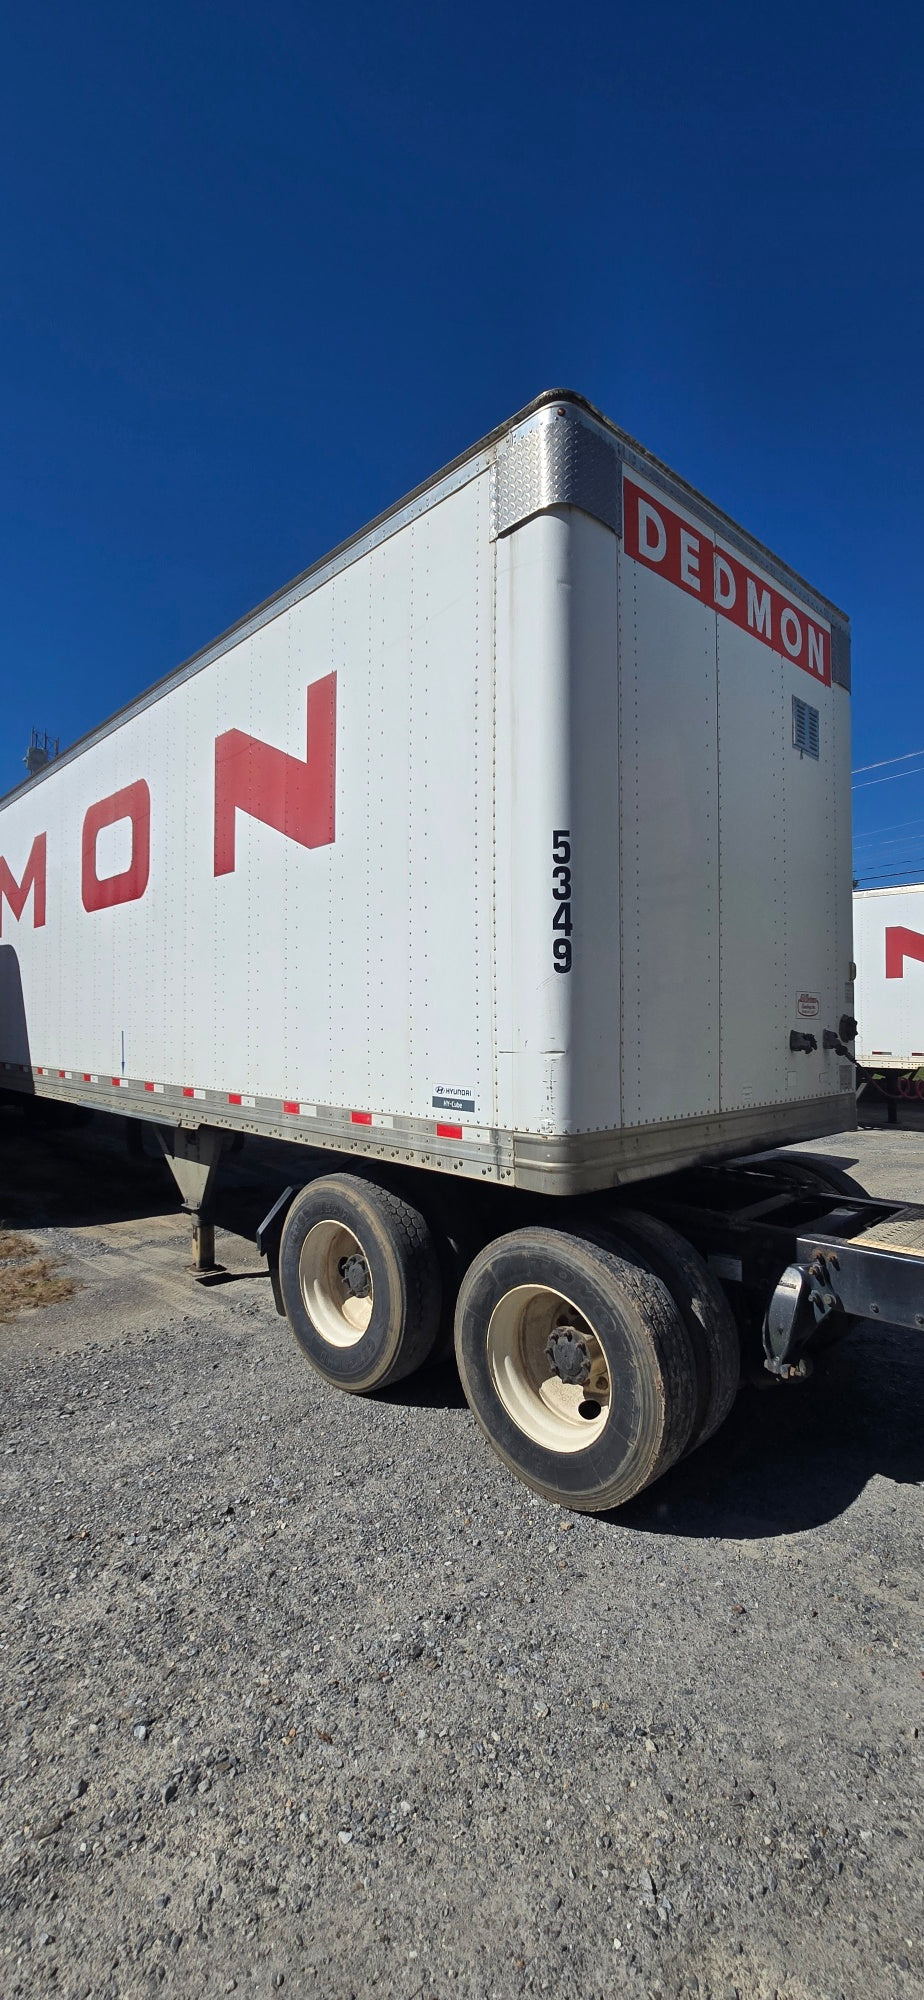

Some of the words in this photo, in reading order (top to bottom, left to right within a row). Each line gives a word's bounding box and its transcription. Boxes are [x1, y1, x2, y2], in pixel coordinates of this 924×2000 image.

[638, 497, 824, 677] DEDMON
[0, 670, 337, 938] MON
[552, 829, 573, 974] 5349
[445, 1087, 472, 1097] HYUNDAI
